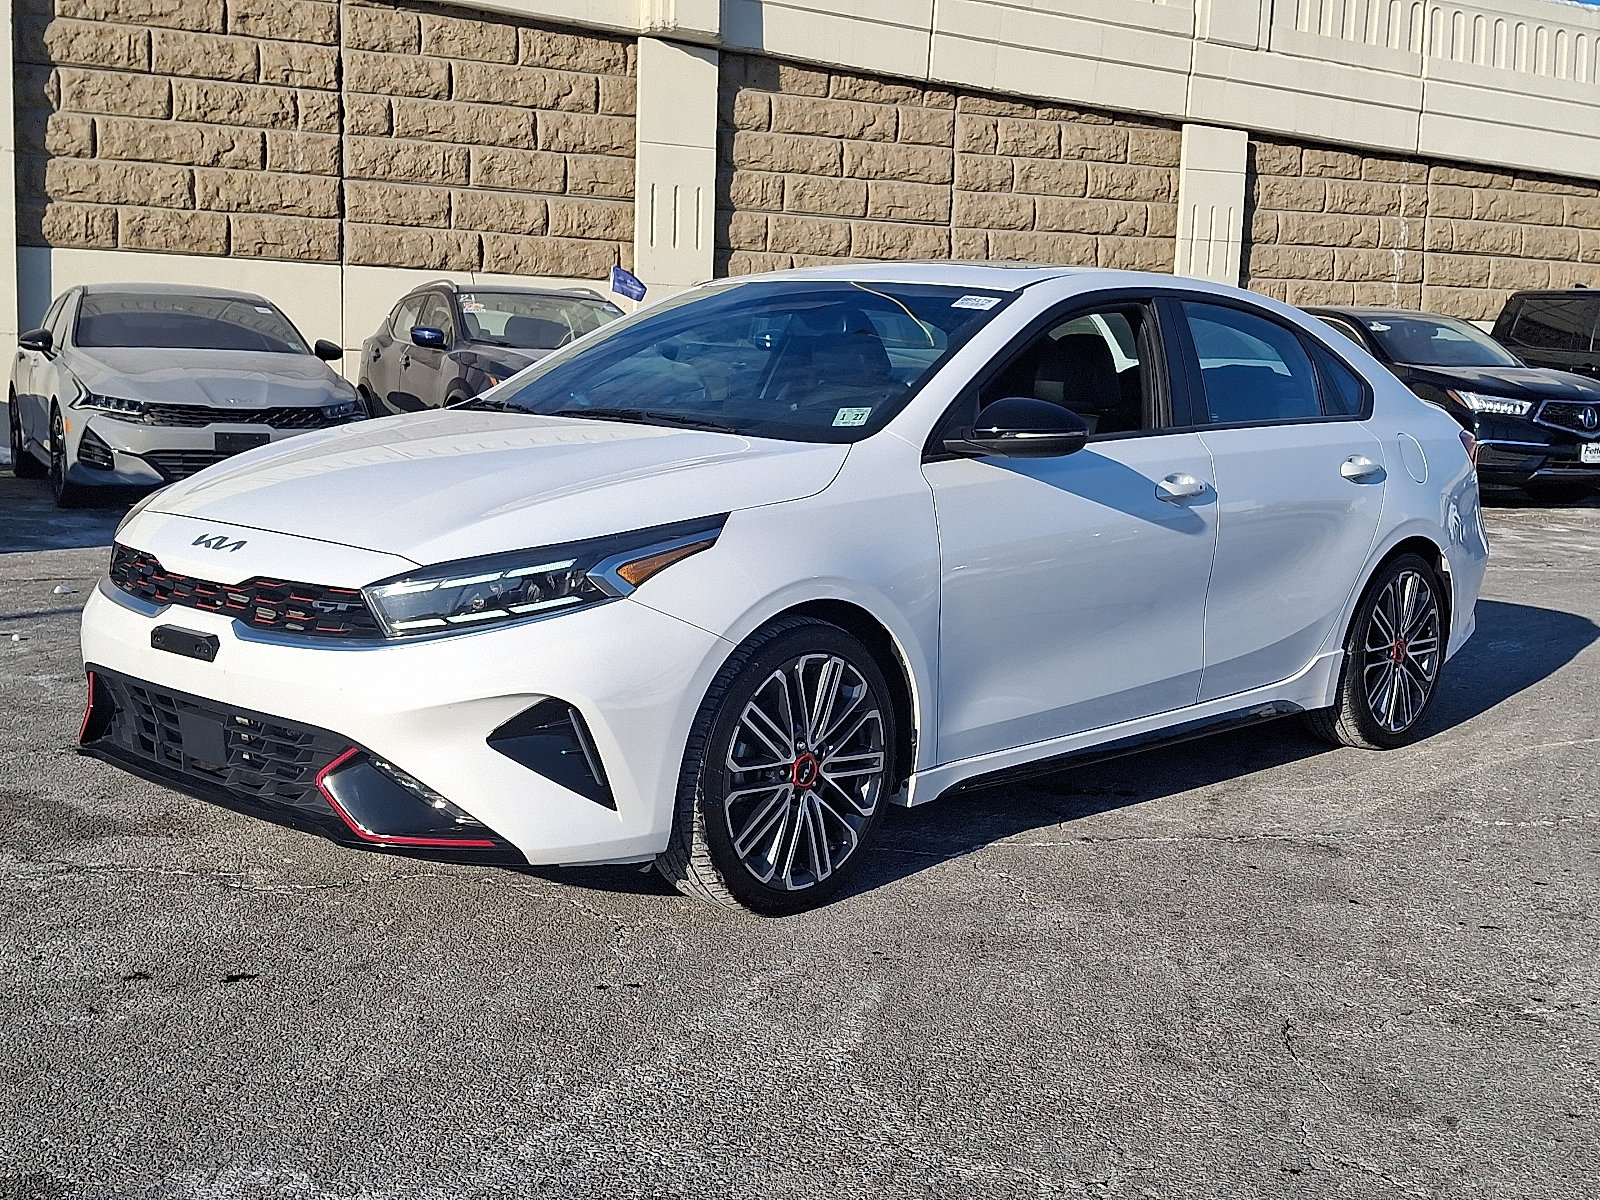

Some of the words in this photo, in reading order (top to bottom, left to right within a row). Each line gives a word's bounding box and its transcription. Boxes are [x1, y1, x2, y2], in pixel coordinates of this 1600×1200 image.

[851, 412, 866, 421] 27
[191, 533, 248, 552] KIA
[311, 600, 363, 613] GT
